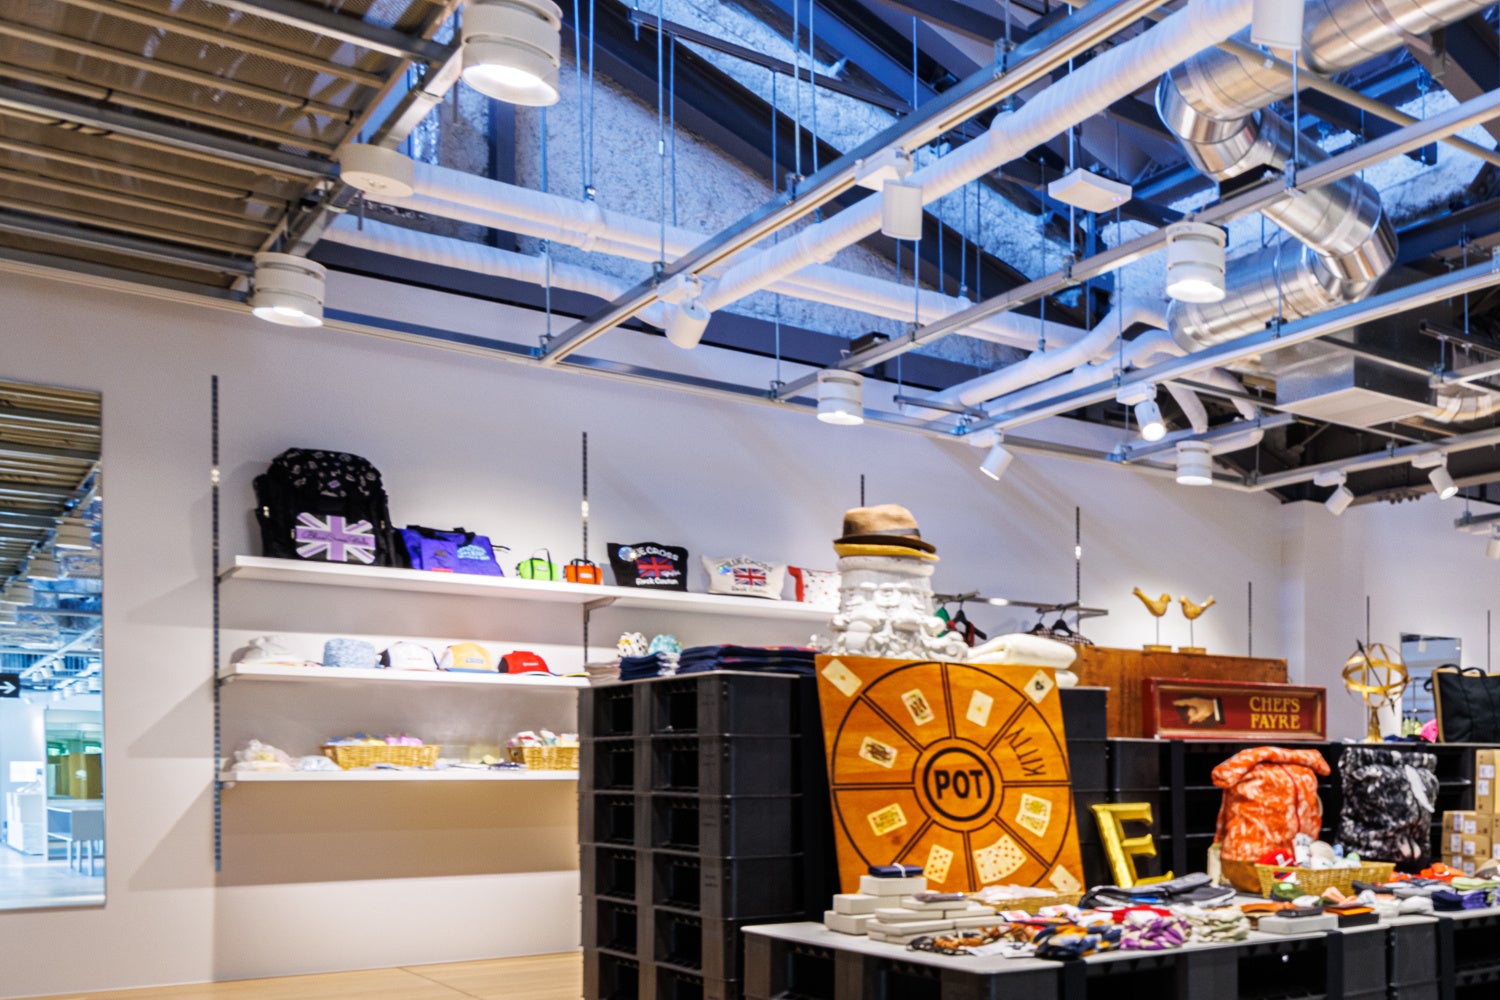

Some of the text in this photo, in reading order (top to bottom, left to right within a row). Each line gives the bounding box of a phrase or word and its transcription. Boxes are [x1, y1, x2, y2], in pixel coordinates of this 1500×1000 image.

[1249, 696, 1301, 713] CHEFS
[1004, 727, 1047, 777] KITTY
[934, 769, 984, 800] POT
[1088, 802, 1175, 889] E
